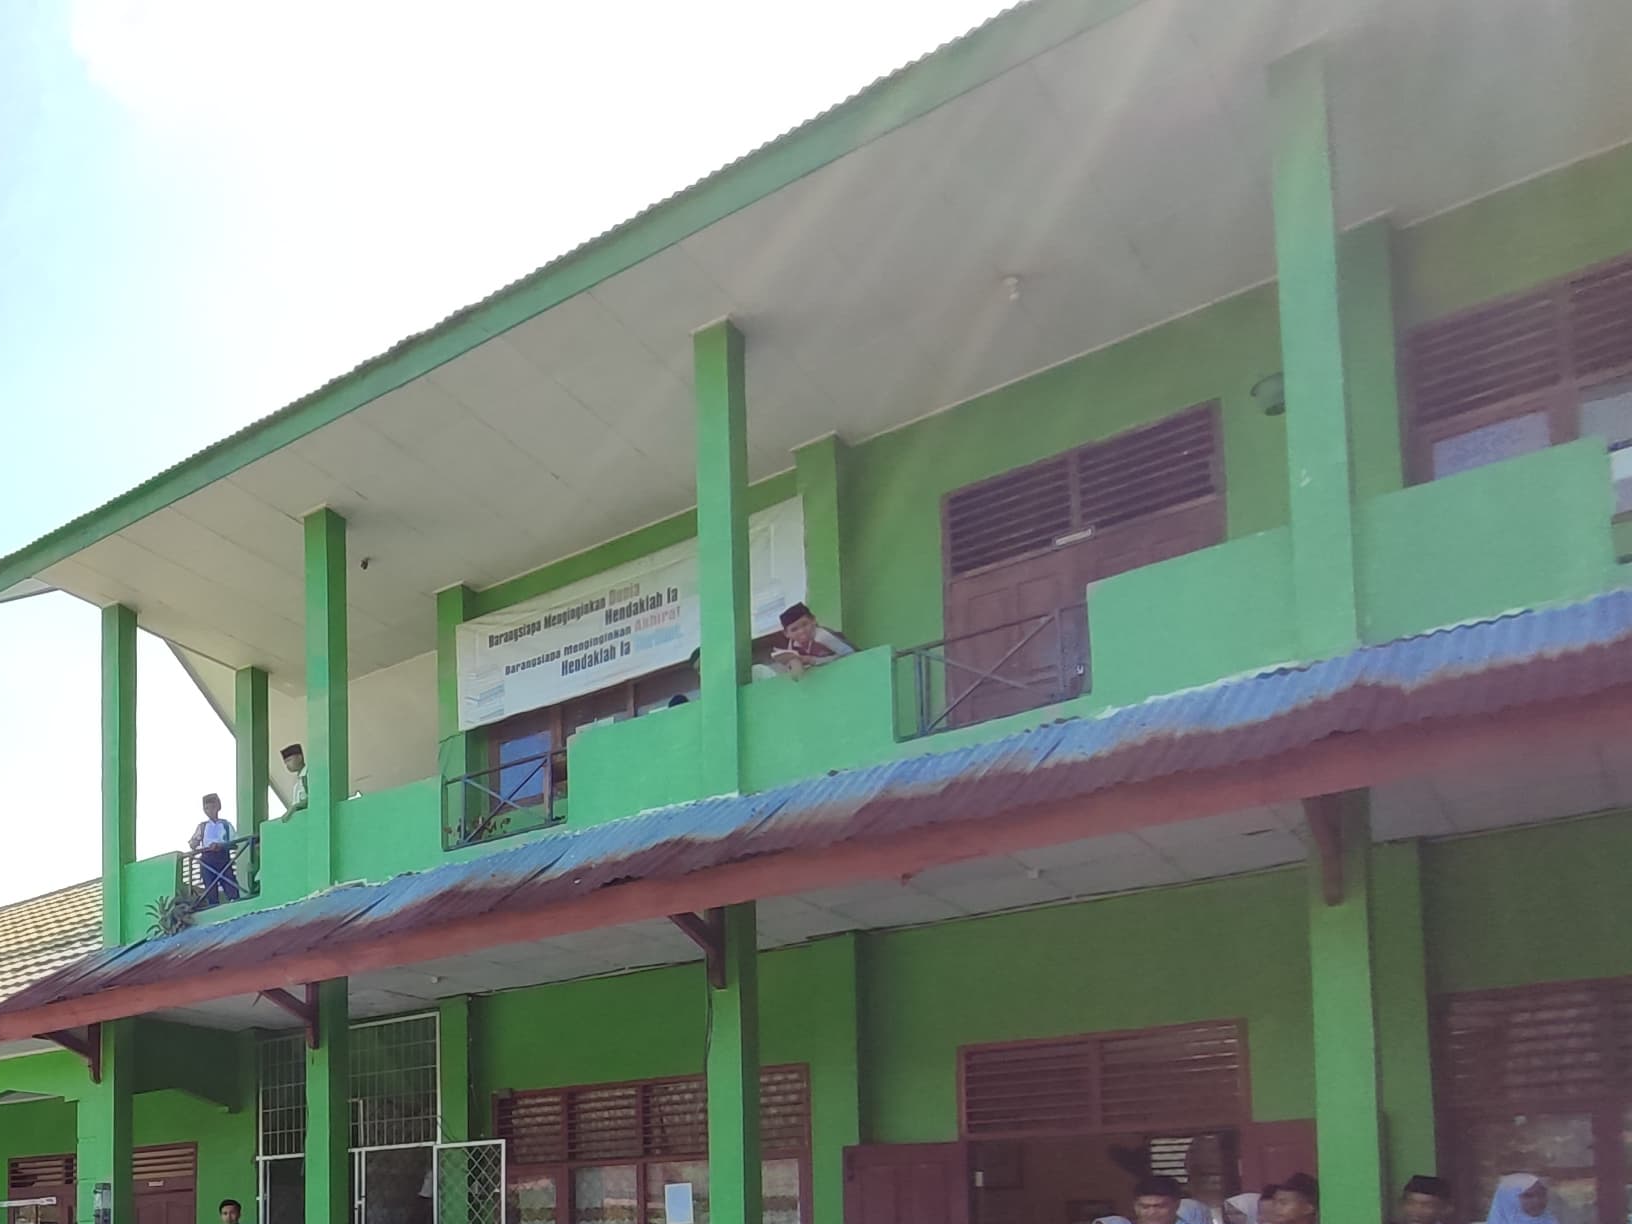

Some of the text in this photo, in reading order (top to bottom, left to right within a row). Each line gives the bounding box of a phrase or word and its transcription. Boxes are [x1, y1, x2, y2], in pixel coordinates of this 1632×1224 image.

[605, 591, 663, 625] Hendaklah
[488, 619, 542, 648] Barangsiapa
[561, 645, 617, 677] Hendaklah
